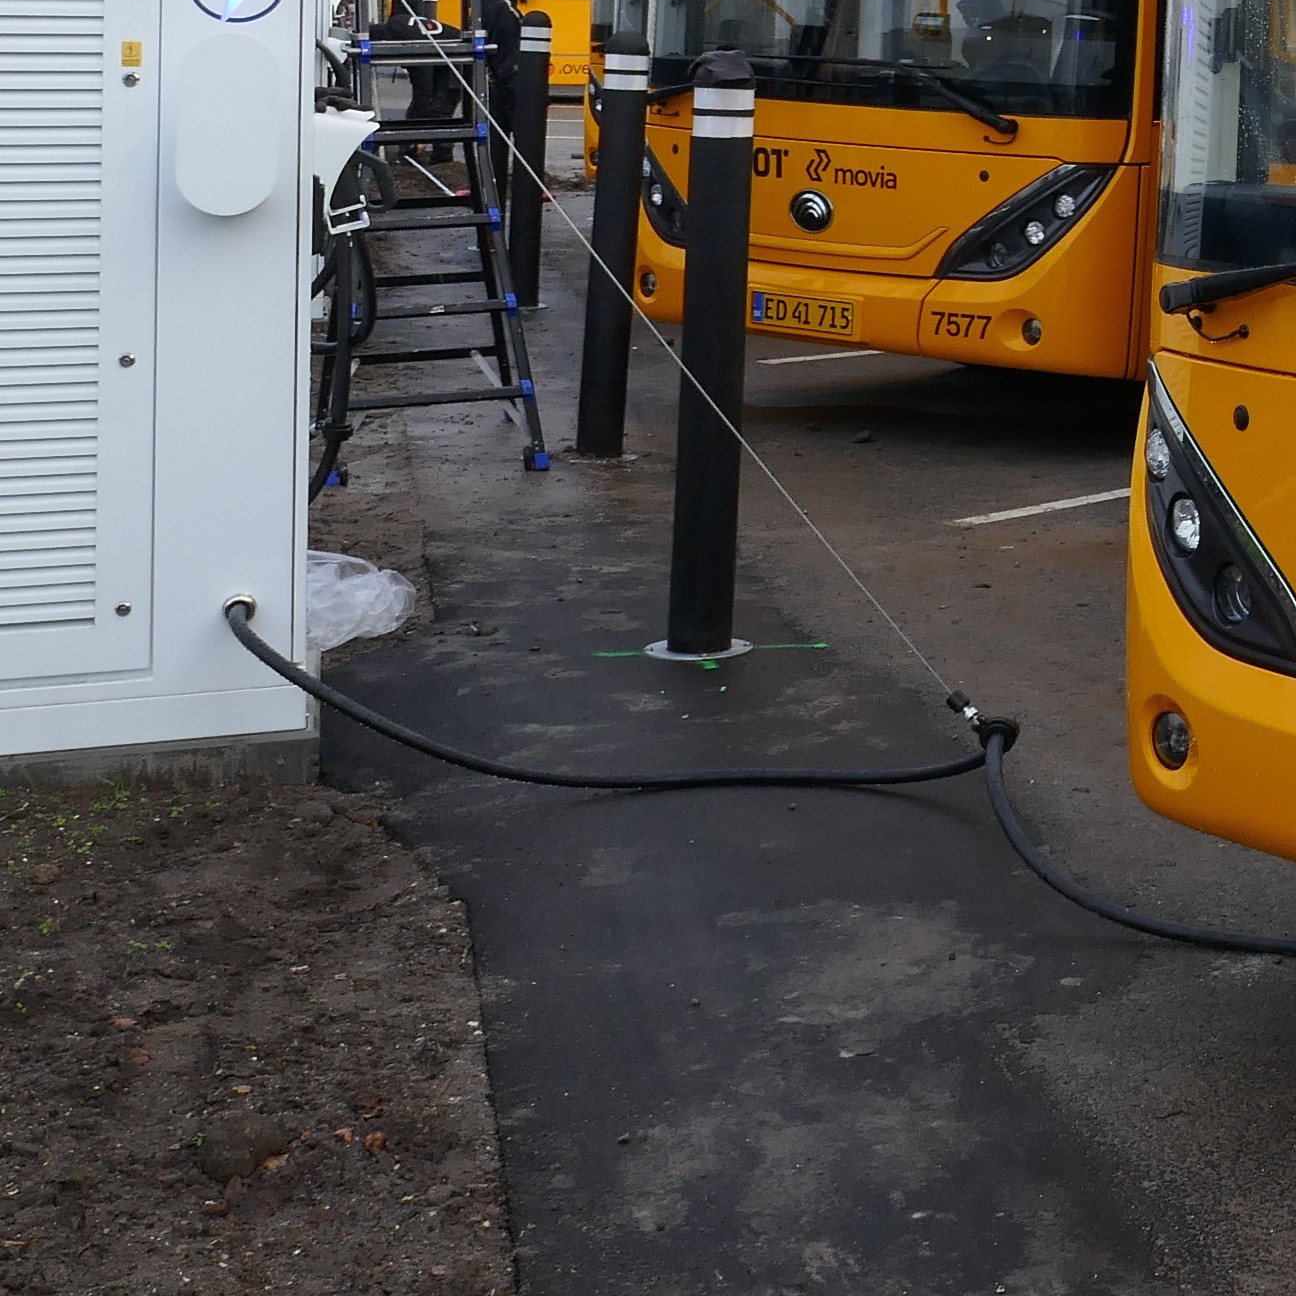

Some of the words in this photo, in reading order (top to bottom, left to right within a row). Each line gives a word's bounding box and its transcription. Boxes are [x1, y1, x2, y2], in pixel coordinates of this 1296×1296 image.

[753, 147, 789, 178] OT
[834, 165, 897, 189] movia
[765, 297, 788, 320] ED
[792, 301, 811, 325] 41
[817, 304, 851, 330] 715
[931, 311, 993, 340] 7577
